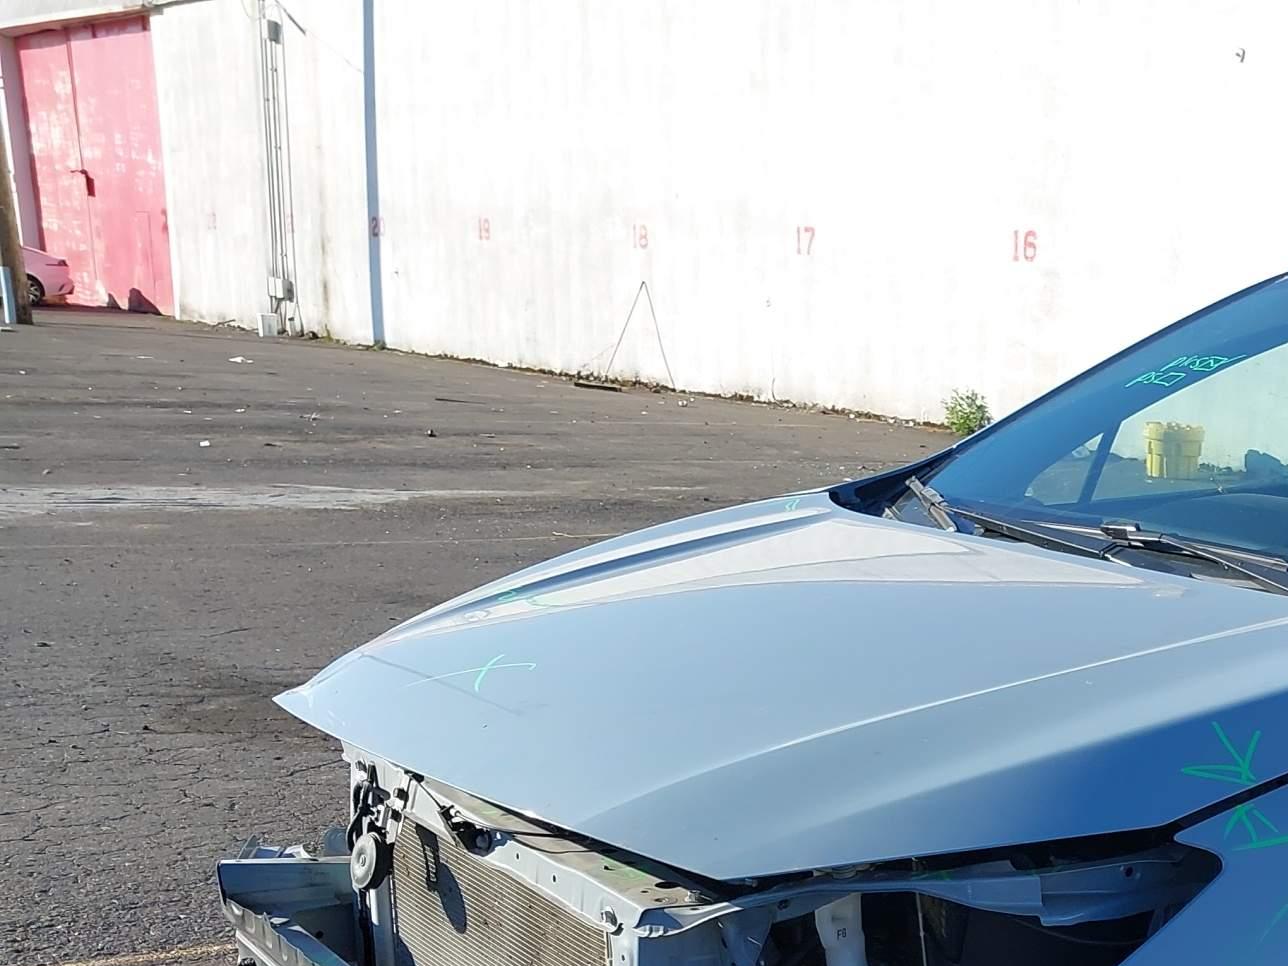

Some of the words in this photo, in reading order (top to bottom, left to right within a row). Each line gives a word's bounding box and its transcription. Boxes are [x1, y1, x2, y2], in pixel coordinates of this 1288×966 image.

[478, 217, 491, 241] 19
[633, 223, 649, 249] 18
[796, 226, 816, 256] 17
[1012, 229, 1037, 262] 16
